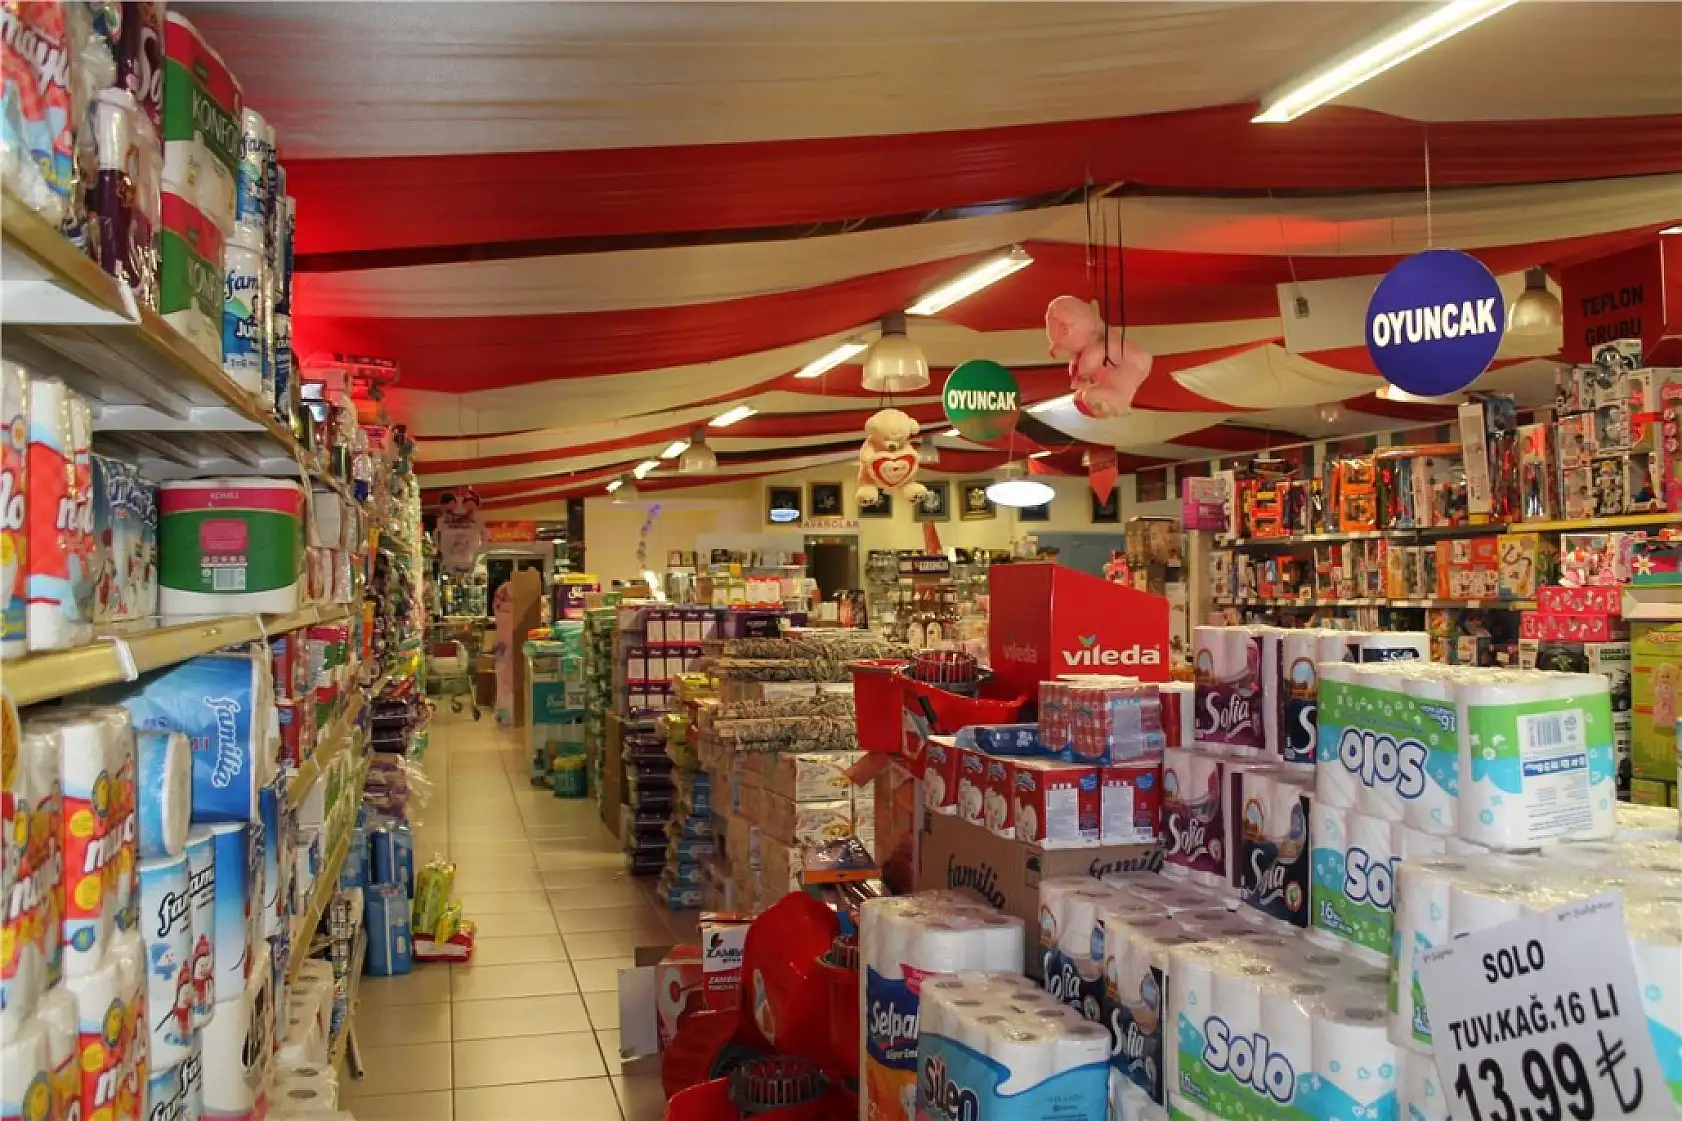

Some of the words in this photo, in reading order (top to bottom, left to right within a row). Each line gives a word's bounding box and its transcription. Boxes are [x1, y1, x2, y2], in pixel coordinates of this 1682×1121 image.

[1373, 297, 1497, 348] OYUNCAK
[1581, 284, 1644, 318] TEFLON
[1585, 316, 1642, 347] GRUBU
[947, 389, 1017, 411] OYUNCAK
[1062, 644, 1161, 667] vileda
[1203, 692, 1250, 735] Sofia
[205, 696, 242, 789] familia
[1339, 727, 1428, 800] Solo
[1164, 813, 1206, 858] Sofia
[1043, 950, 1082, 1003] Sofia
[1482, 939, 1545, 984] SOLO
[1449, 992, 1586, 1051] TUV.KAĞ.16
[1590, 983, 1620, 1020] LI
[1203, 1015, 1296, 1104] Solo
